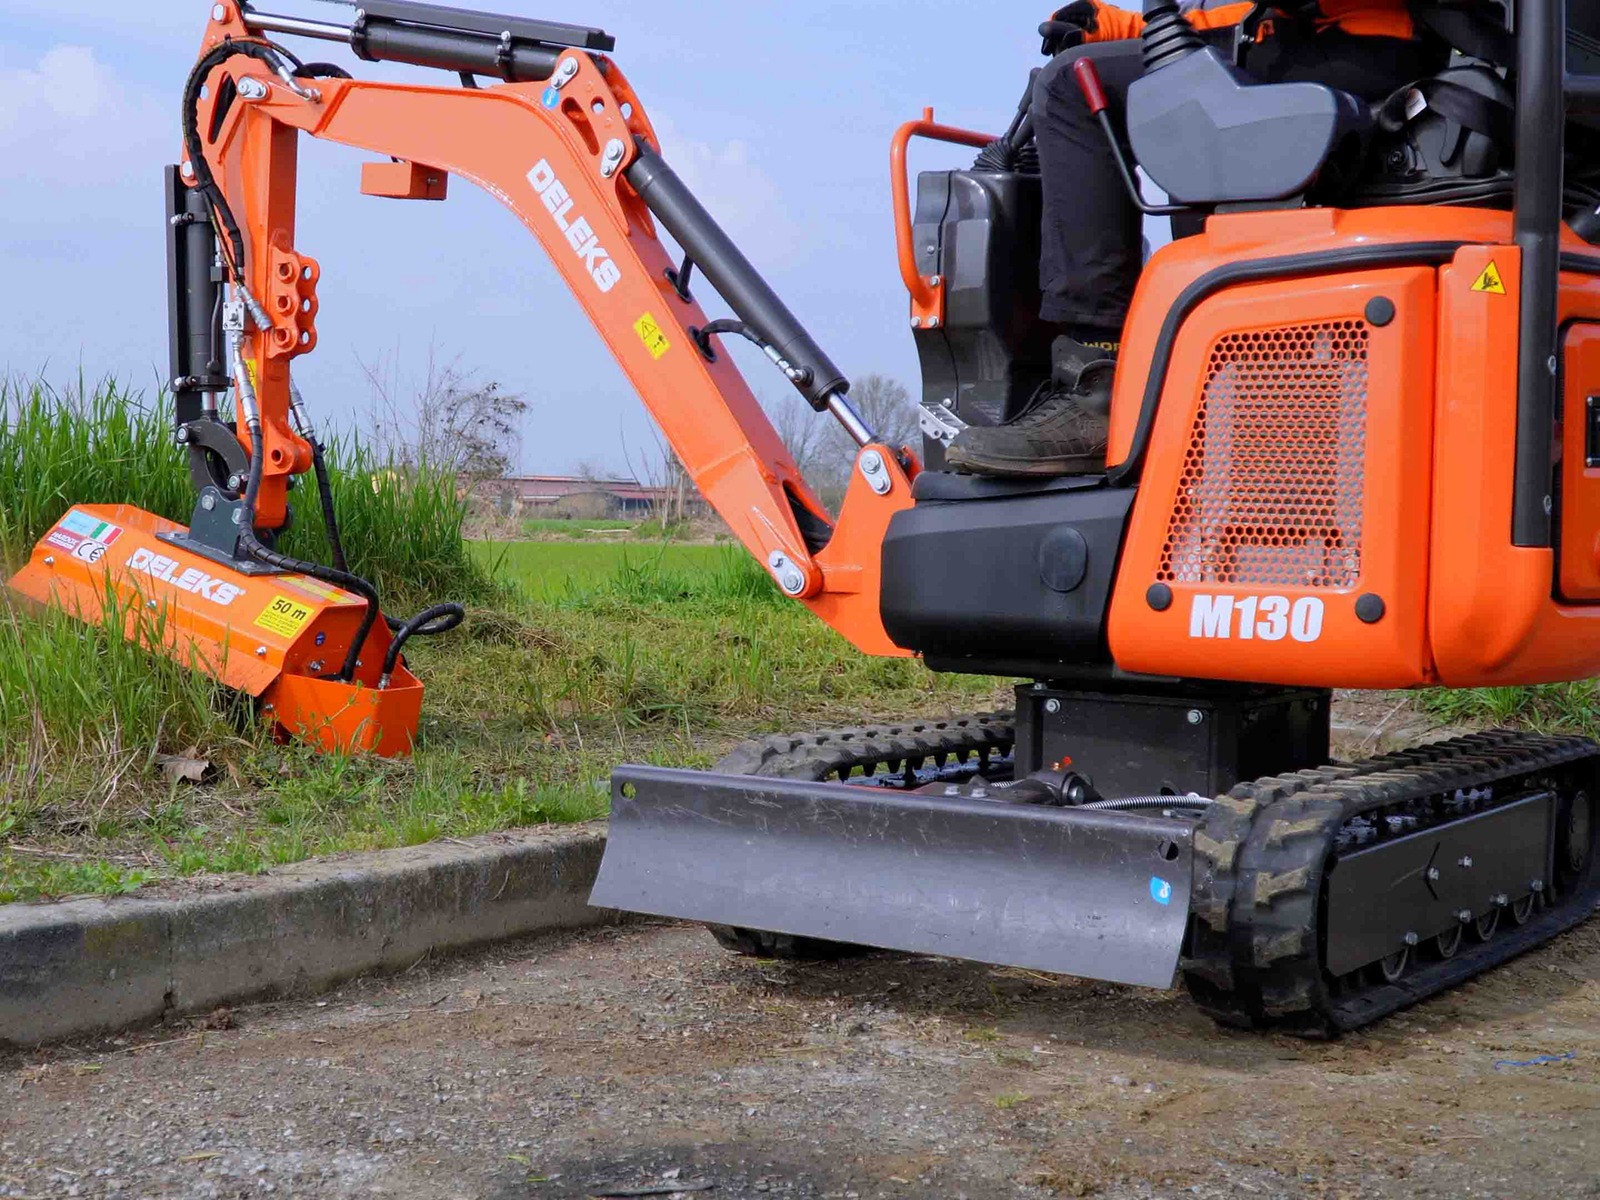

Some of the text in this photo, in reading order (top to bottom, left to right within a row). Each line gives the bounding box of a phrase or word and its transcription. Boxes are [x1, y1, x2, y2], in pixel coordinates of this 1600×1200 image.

[525, 158, 622, 293] DELEKS
[125, 547, 240, 606] DELEKS
[272, 599, 307, 621] 50 m
[1189, 594, 1325, 643] M130
